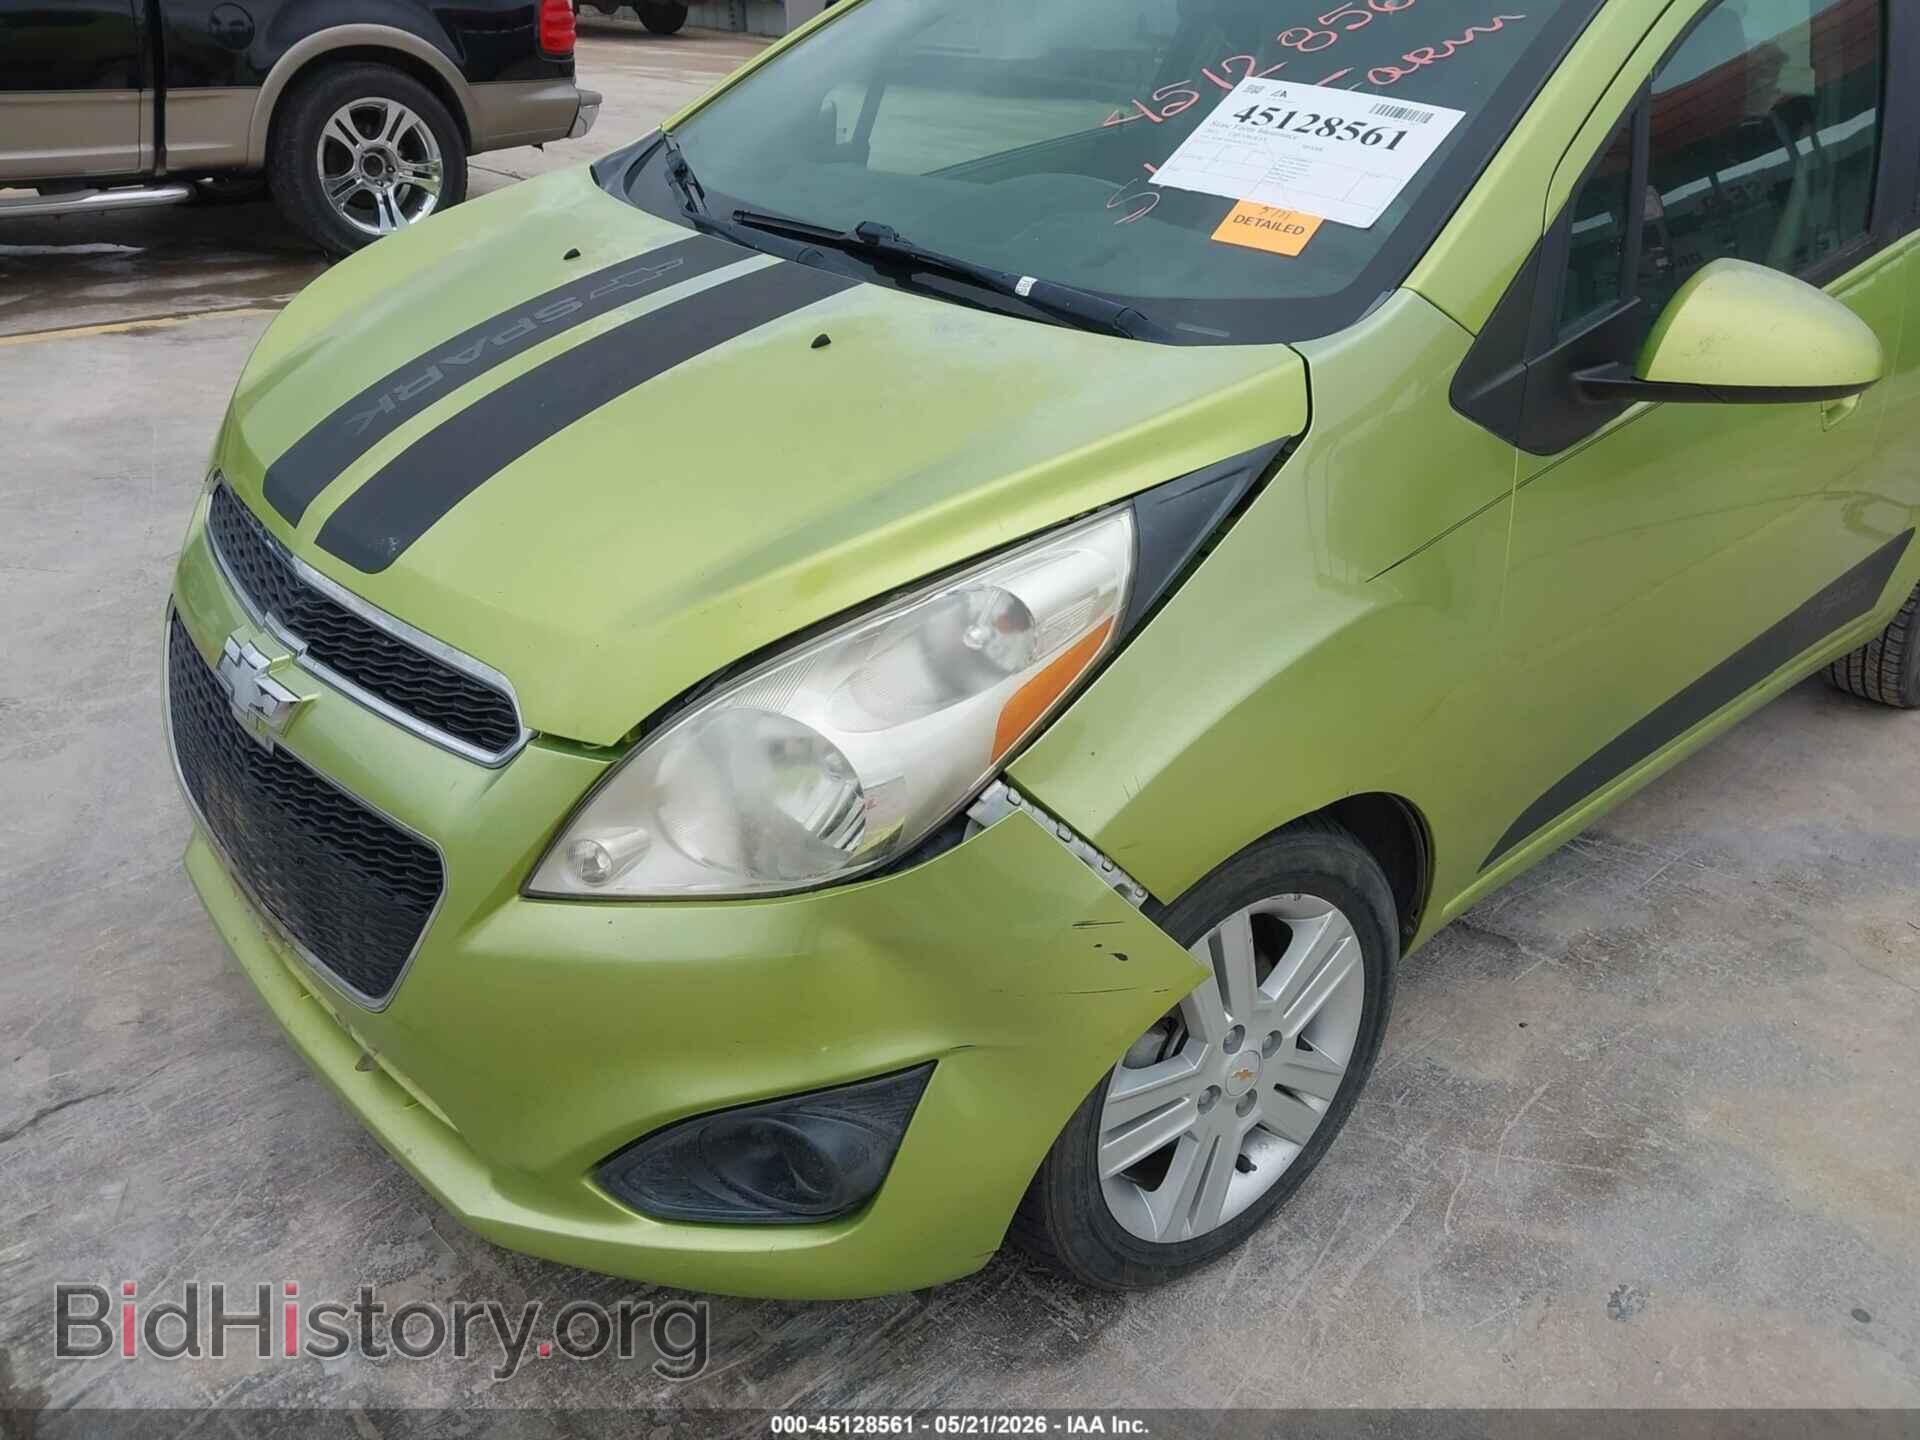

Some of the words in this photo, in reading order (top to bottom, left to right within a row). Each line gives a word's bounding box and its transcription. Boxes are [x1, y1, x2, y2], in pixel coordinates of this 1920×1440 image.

[1233, 104, 1408, 150] 45128561
[1232, 213, 1305, 236] DETAILED
[344, 296, 584, 435] SPARK
